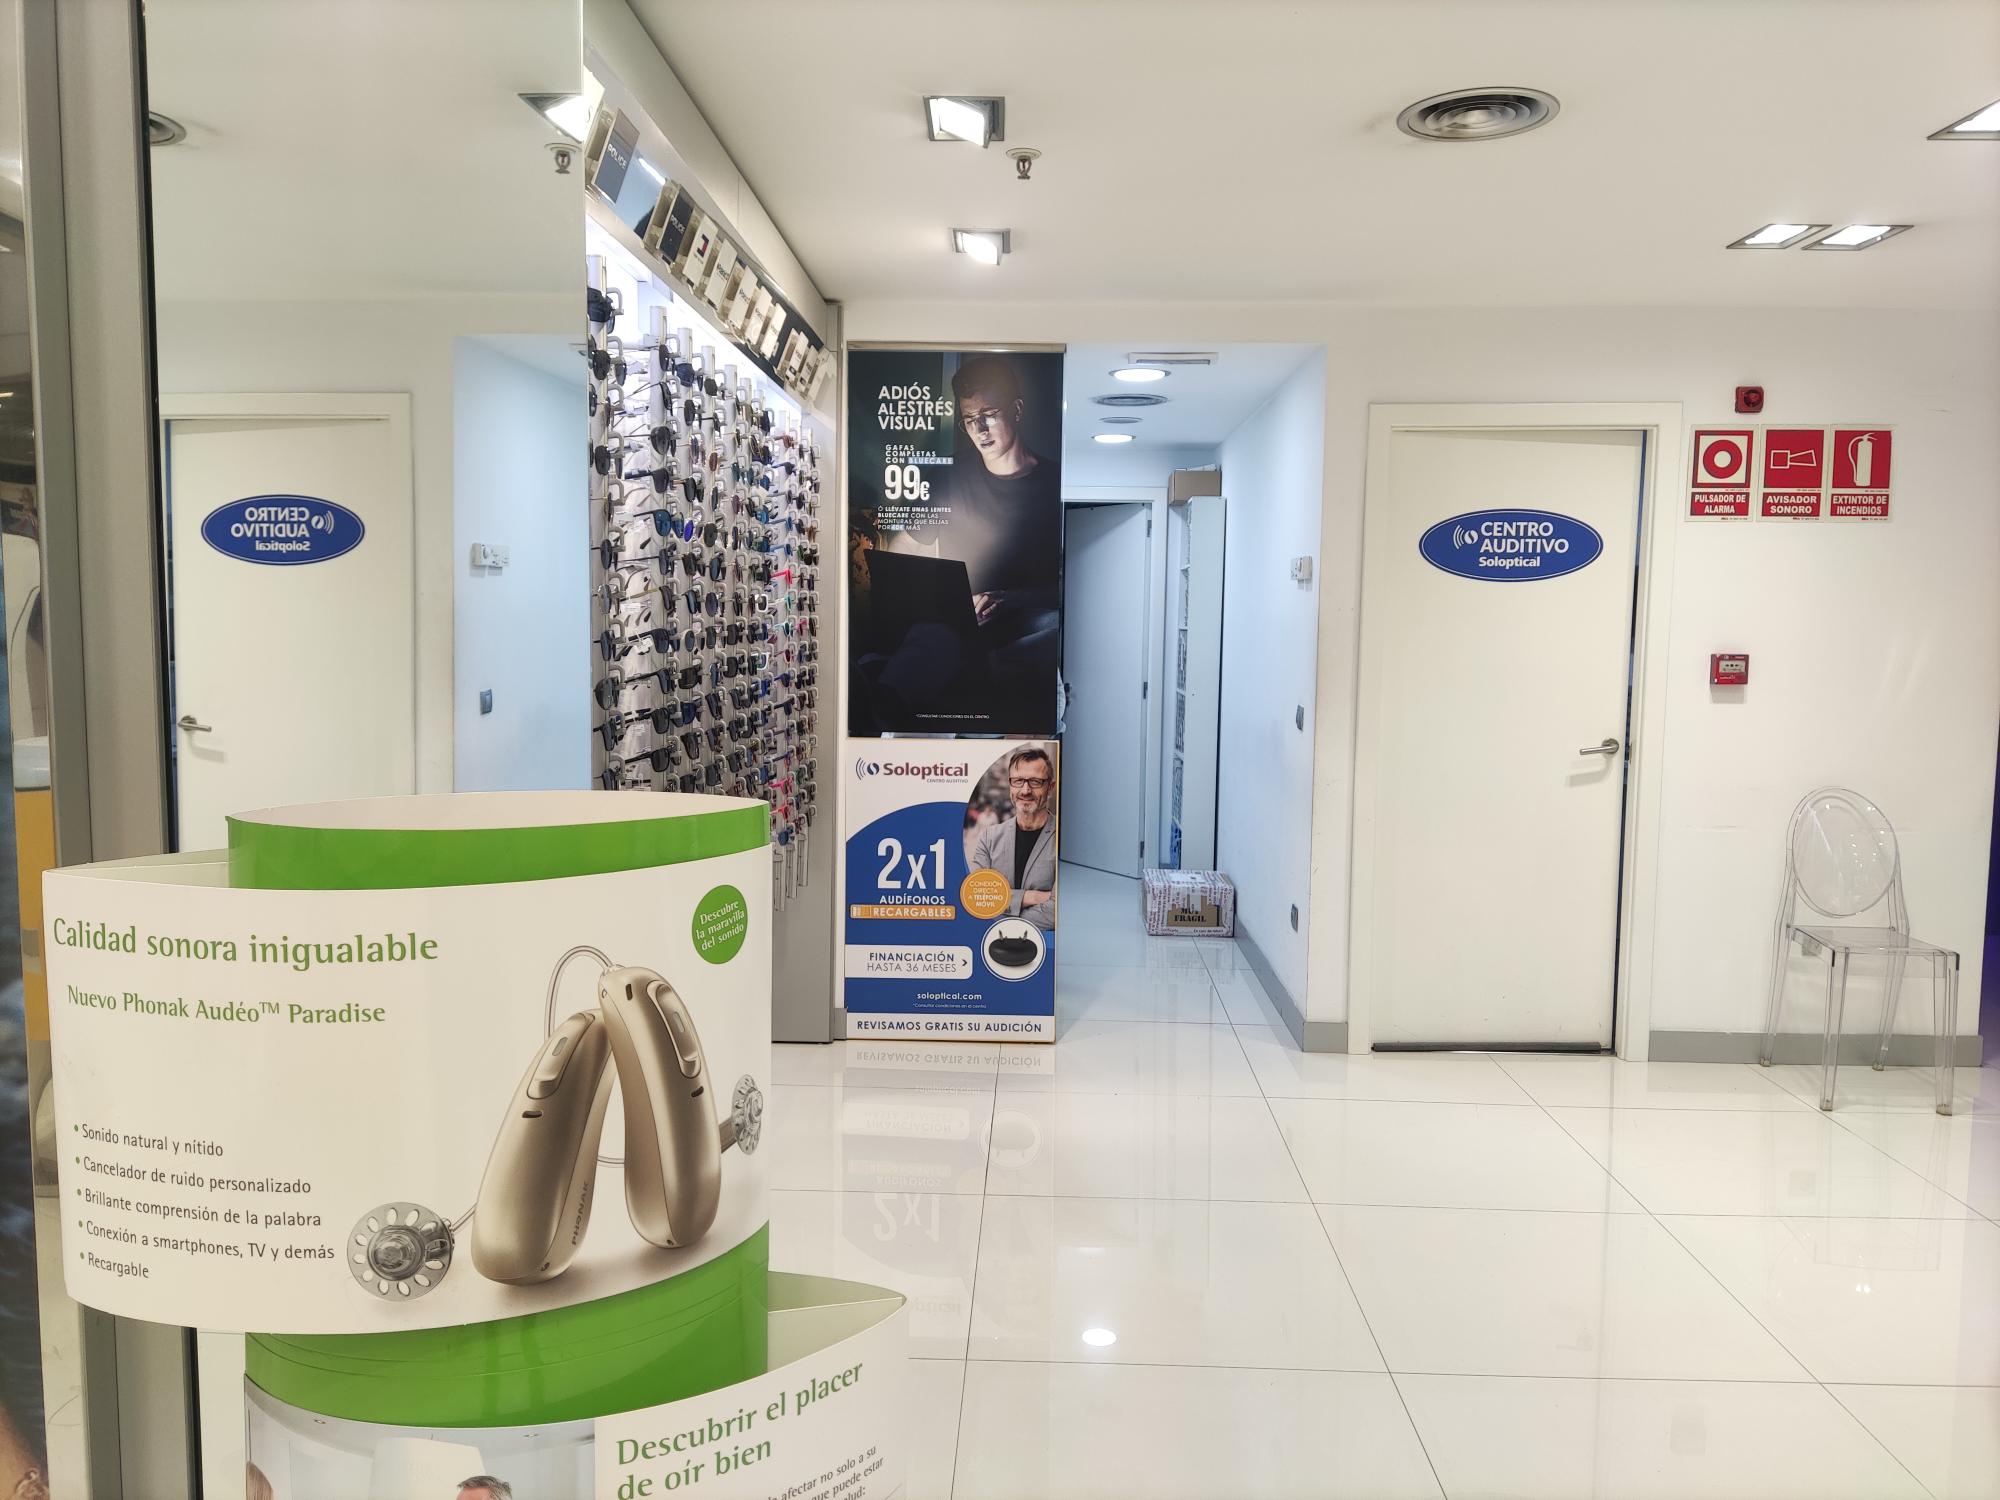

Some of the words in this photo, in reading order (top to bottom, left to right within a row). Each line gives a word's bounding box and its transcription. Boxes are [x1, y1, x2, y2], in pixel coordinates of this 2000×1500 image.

[608, 144, 627, 170] POLICE
[671, 214, 686, 234] POLICE
[878, 382, 930, 400] ADIÓS
[878, 404, 896, 415] AL
[898, 397, 953, 416] ESTRÉS
[878, 416, 934, 430] VISUAL
[884, 464, 930, 500] 99€
[1694, 494, 1734, 503] PULSADOR
[1736, 494, 1746, 503] DE
[1767, 495, 1817, 503] AVISADOR
[1833, 496, 1874, 504] EXTINTOR
[1876, 496, 1887, 504] DE
[1704, 505, 1735, 514] ALARMA
[1770, 505, 1812, 514] SONORO
[1836, 506, 1882, 515] INCENDIOS
[1480, 522, 1554, 537] CENTRO
[1480, 538, 1569, 554] AUDITIVO
[1478, 556, 1540, 570] Soloptical
[883, 762, 968, 780] Soloptical
[877, 837, 946, 890] 2x1
[879, 893, 946, 905] AUDÍFONOS
[700, 901, 738, 924] Descubre
[873, 907, 952, 917] RECARGABLES
[696, 929, 705, 940] la
[708, 910, 744, 935] maravilla
[53, 917, 136, 954] Calidad
[147, 933, 237, 961] sonora
[250, 932, 438, 971] inigualable
[701, 936, 715, 951] del
[718, 924, 744, 943] sonido
[869, 951, 954, 962] FINANCIACIÓN
[867, 963, 902, 972] HASTA
[906, 963, 919, 972] 36
[923, 964, 956, 972] MESES
[67, 985, 117, 1010] Nuevo
[123, 992, 189, 1019] Phonak
[289, 1003, 386, 1024] Paradise
[917, 992, 982, 1000] soloptical.com
[857, 1021, 920, 1031] REVISAMOS
[925, 1022, 964, 1031] GRATIS
[968, 1022, 980, 1032] SU
[985, 1021, 1042, 1032] AUDICIÓN
[82, 1123, 119, 1144] Sonido
[123, 1133, 168, 1151] natural
[173, 1141, 180, 1154] y
[185, 1139, 223, 1157] nítido
[84, 1156, 147, 1181] Cancelador
[151, 1168, 166, 1183] de
[171, 1171, 204, 1188] ruido
[210, 1178, 311, 1194] personalizado
[85, 1188, 132, 1212] Brillante
[136, 1200, 218, 1222] comprensión
[224, 1208, 240, 1224] de
[246, 1209, 259, 1225] la
[264, 1211, 321, 1229] palabra
[572, 1180, 588, 1246] PHONAK
[86, 1220, 137, 1244] Conexión
[141, 1235, 149, 1247] a
[153, 1234, 243, 1259] smartphones,
[248, 1242, 266, 1258] TV
[271, 1246, 279, 1261] y
[284, 1243, 335, 1260] demás
[88, 1251, 149, 1279] Recargable
[616, 1408, 757, 1465] Descubrir
[766, 1391, 786, 1422] el
[795, 1362, 863, 1416] placer
[617, 1474, 653, 1500] de
[664, 1459, 705, 1490] oír
[716, 1440, 771, 1476] bien
[780, 1478, 818, 1500] afectar
[820, 1471, 834, 1484] no
[836, 1458, 856, 1476] solo
[858, 1454, 864, 1464] a
[866, 1446, 876, 1459] su
[833, 1472, 862, 1497] puede
[863, 1457, 884, 1477] estar
[844, 1485, 866, 1500] lud:
